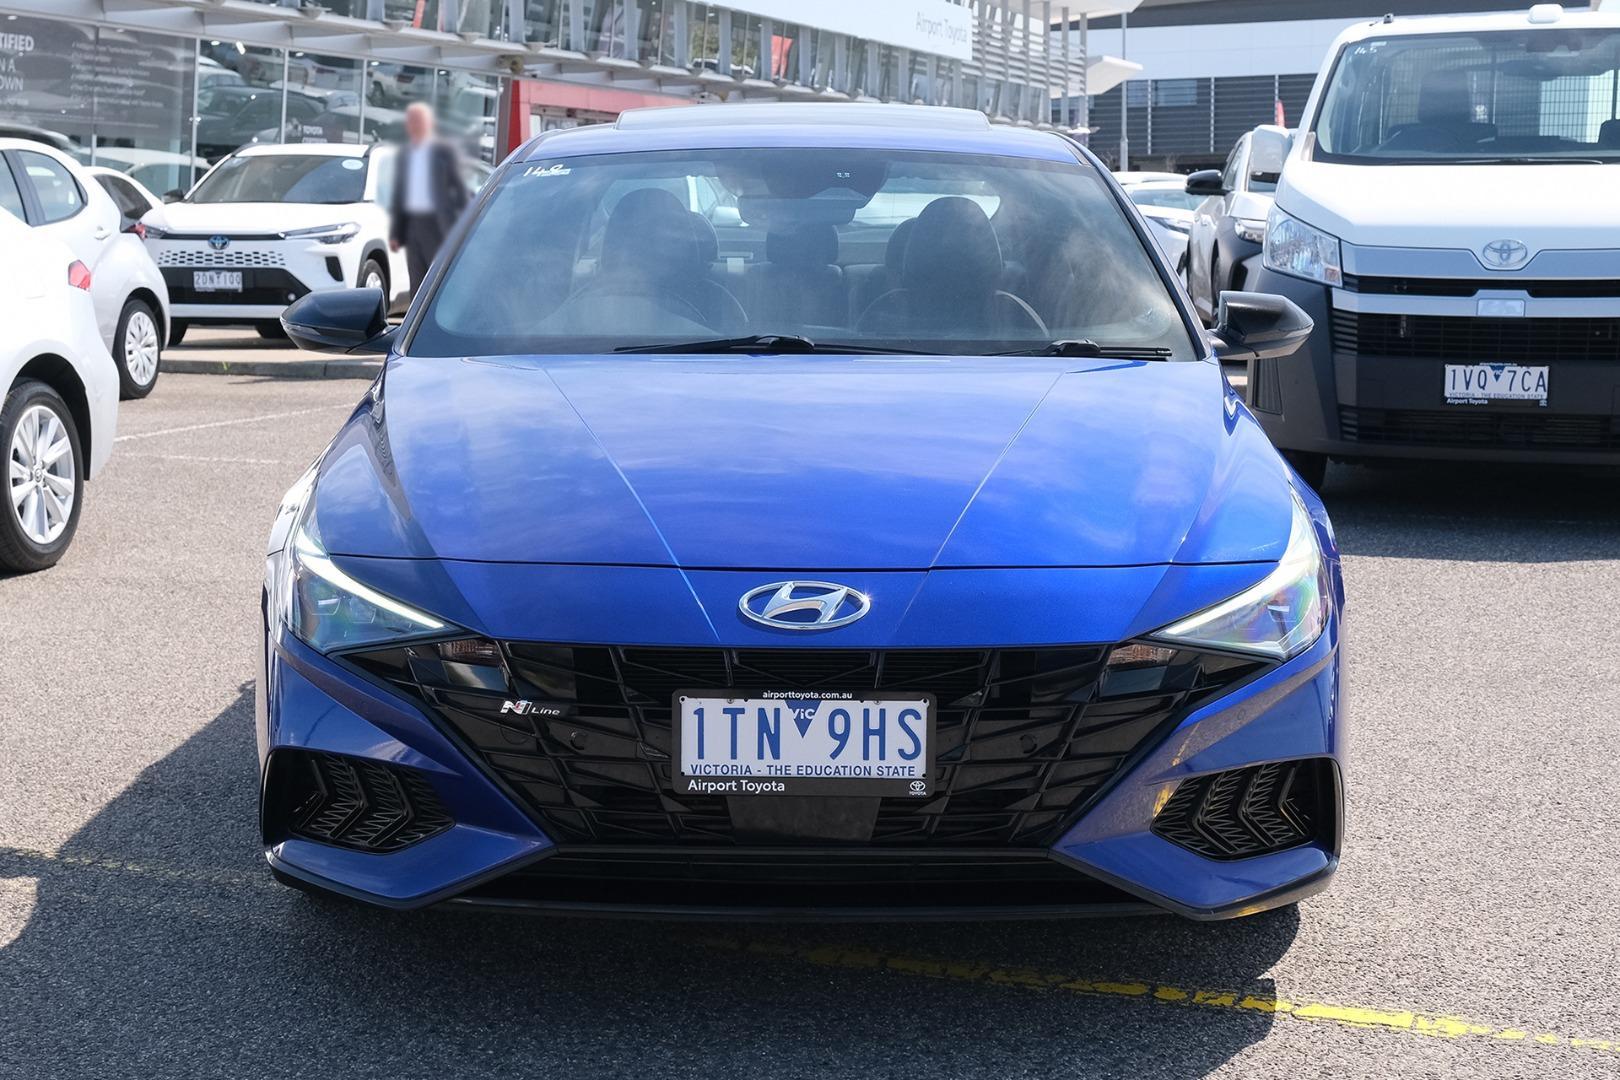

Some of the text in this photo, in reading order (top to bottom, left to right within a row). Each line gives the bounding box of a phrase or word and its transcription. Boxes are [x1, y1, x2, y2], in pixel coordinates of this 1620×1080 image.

[916, 10, 968, 46] Airport Toyota
[762, 690, 853, 700] airporttoyota.com.au
[531, 707, 560, 716] Line
[690, 764, 752, 775] VICTORIA
[766, 765, 792, 776] THE
[796, 765, 872, 776] EDUCATION
[876, 765, 916, 777] STATE
[687, 779, 786, 794] Airport Toyota
